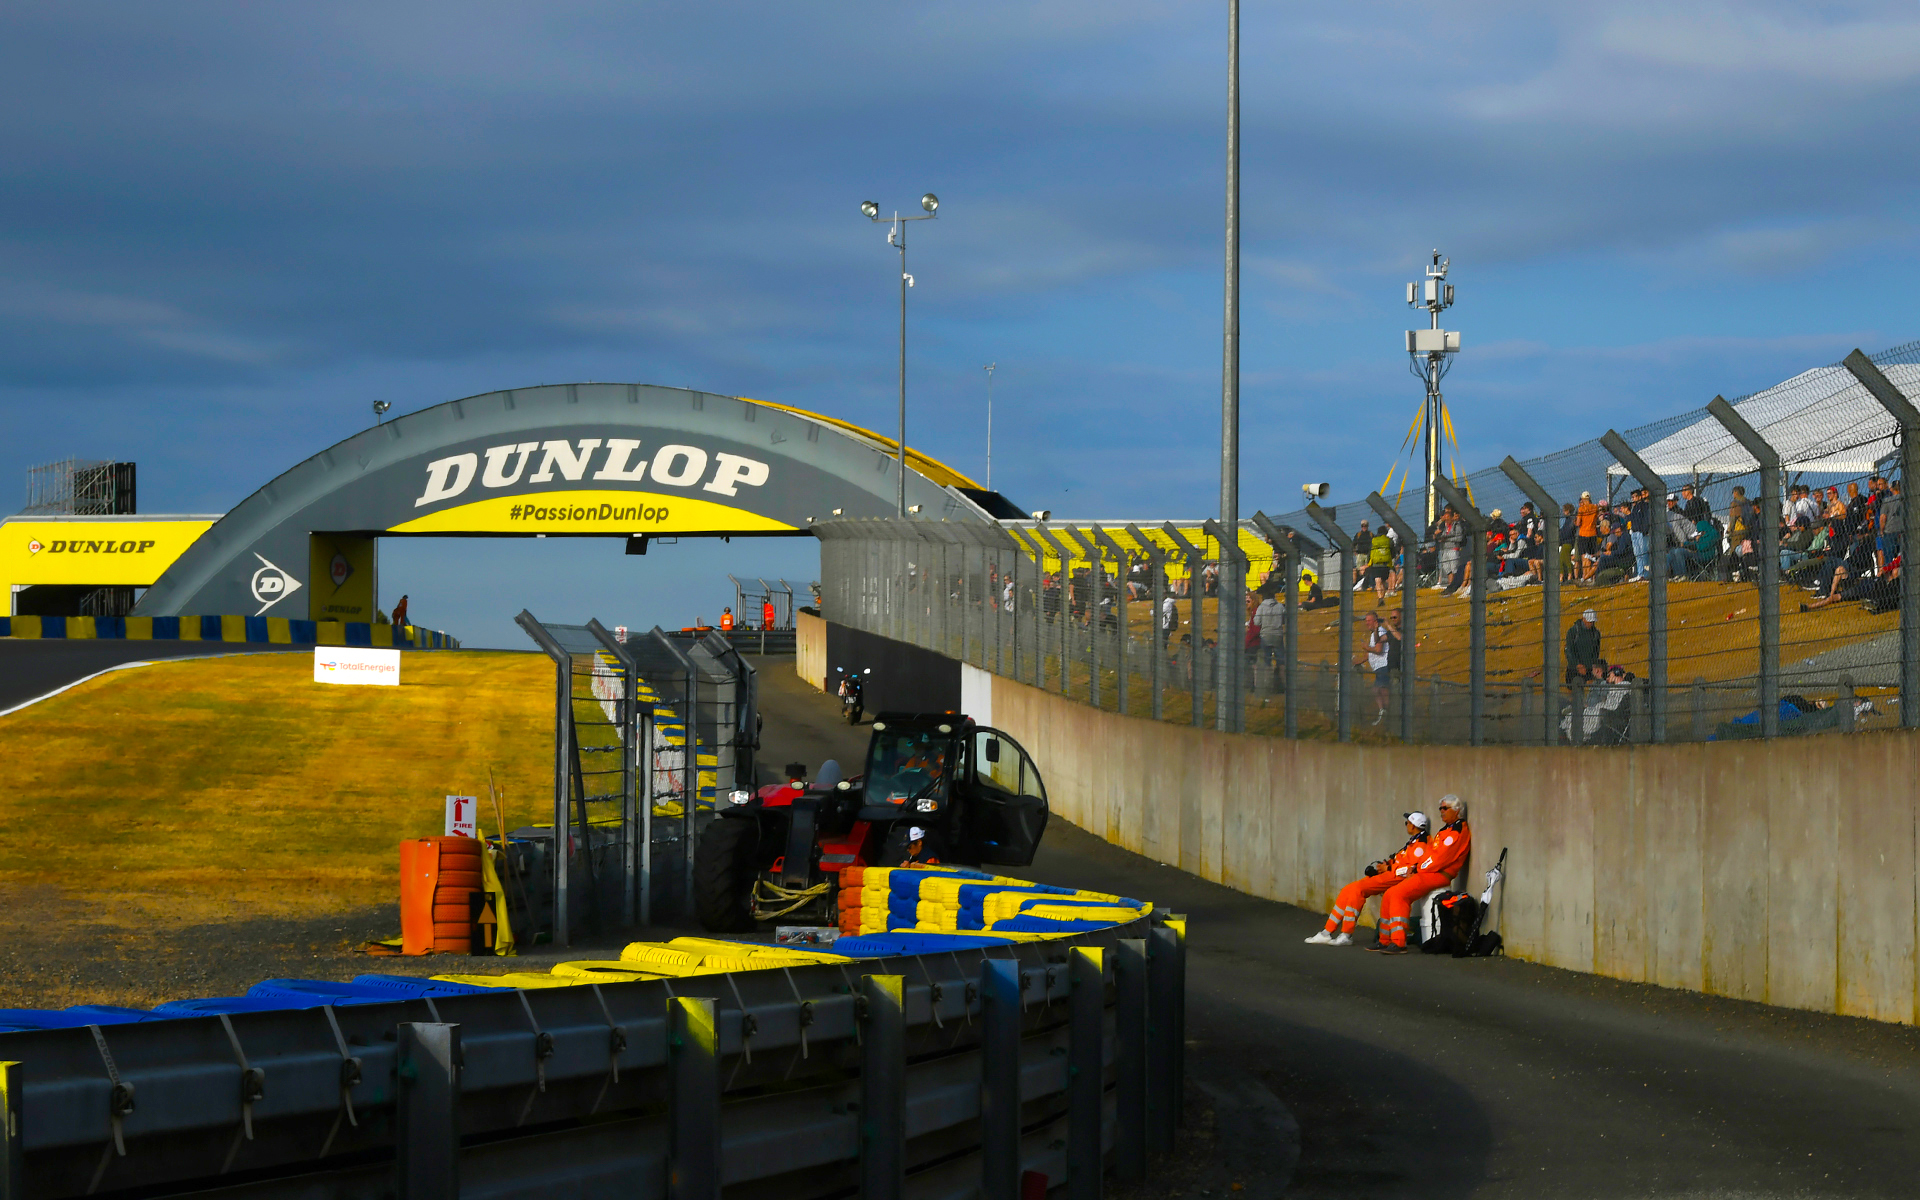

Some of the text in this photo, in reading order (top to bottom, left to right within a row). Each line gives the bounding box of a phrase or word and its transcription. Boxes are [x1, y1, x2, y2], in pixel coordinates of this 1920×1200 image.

[414, 438, 770, 508] DUNLOP
[509, 503, 669, 524] #PassionDunlop
[47, 540, 155, 553] DUNLOP
[327, 605, 362, 614] DUNLOP
[339, 663, 395, 673] TotalEnergies
